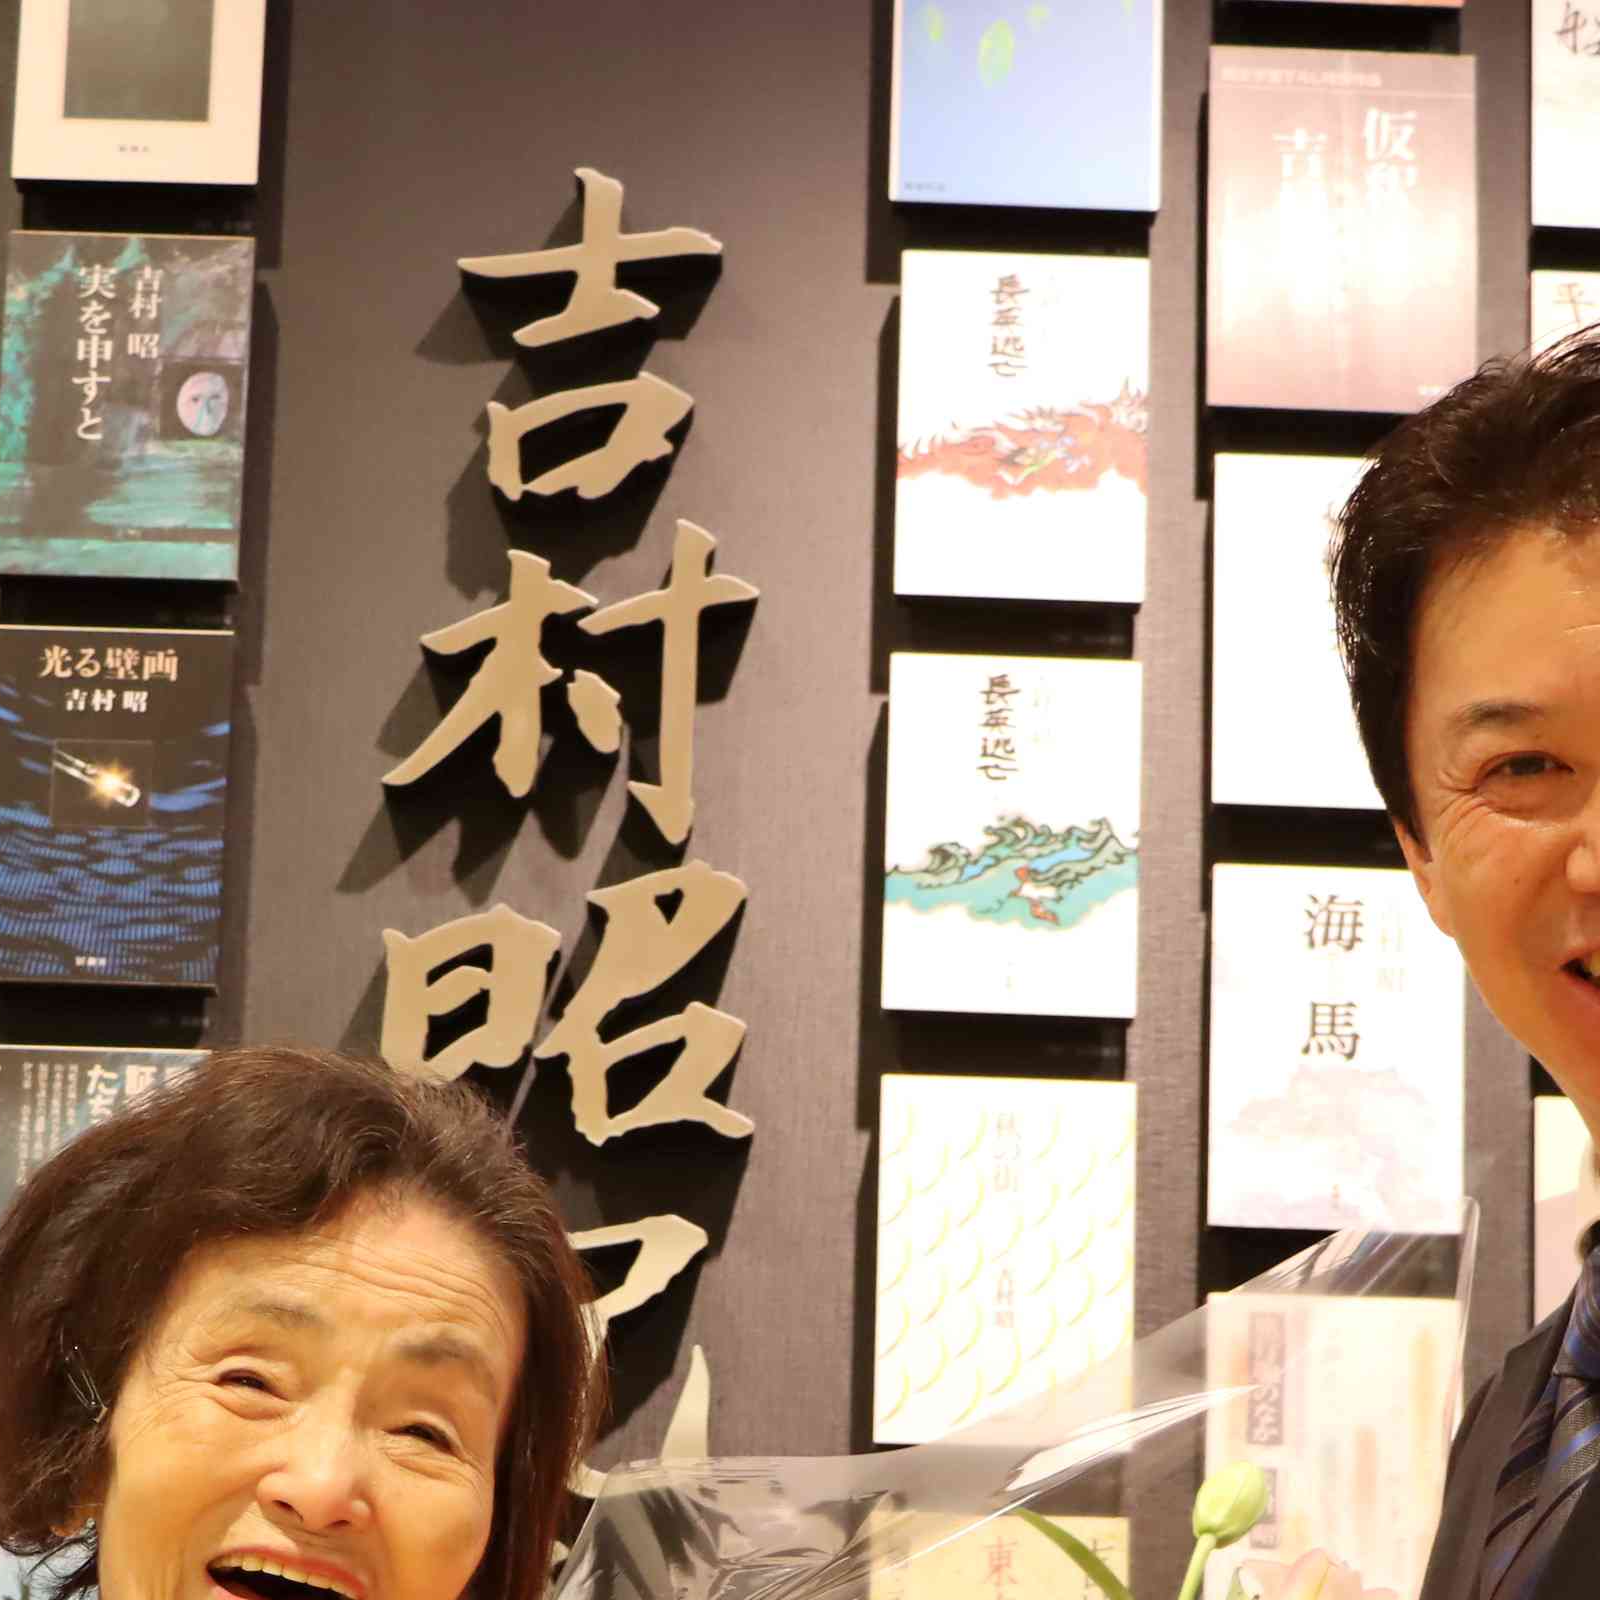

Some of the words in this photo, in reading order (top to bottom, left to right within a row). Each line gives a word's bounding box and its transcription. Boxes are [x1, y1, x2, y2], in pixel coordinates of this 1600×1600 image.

[72, 265, 114, 441] 実を申すと
[128, 265, 162, 360] 吉村昭
[39, 647, 179, 682] 光る壁画
[65, 689, 149, 713] 吉村昭
[1302, 893, 1364, 1061] 海馬
